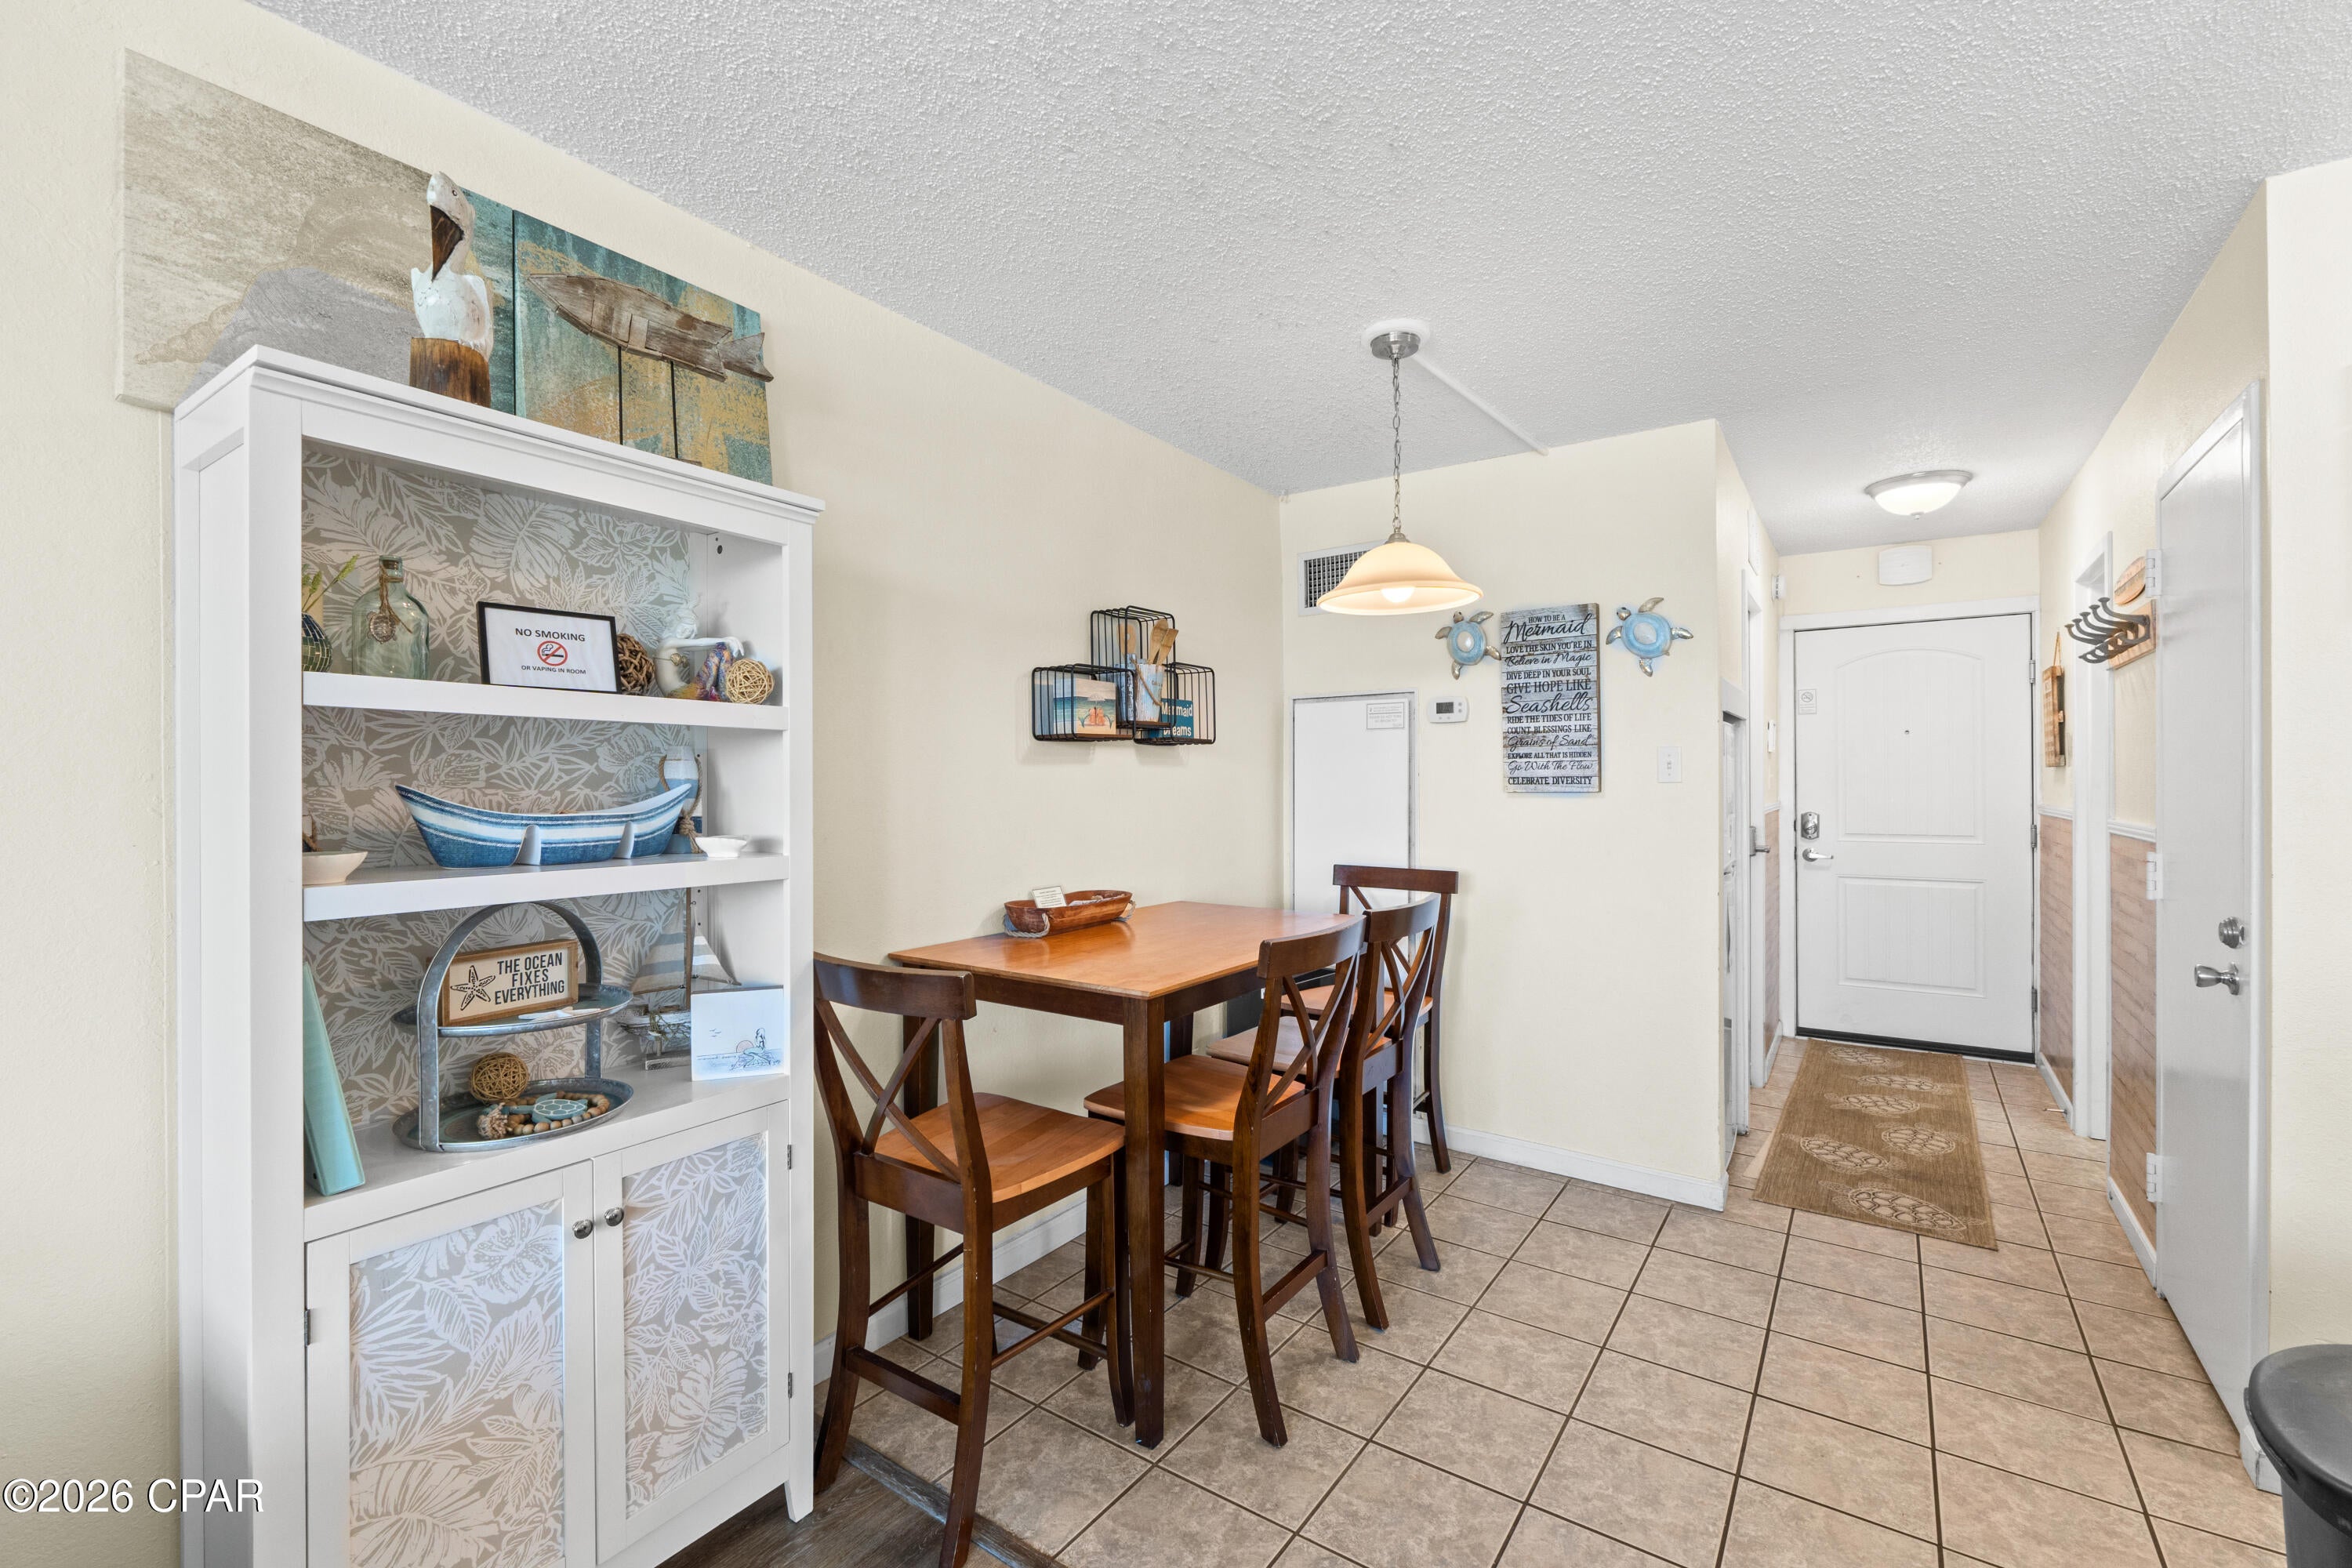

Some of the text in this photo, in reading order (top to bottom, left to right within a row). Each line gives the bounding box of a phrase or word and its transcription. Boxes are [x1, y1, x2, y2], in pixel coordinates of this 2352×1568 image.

[515, 628, 586, 641] NO SMOKING
[1504, 613, 1592, 644] Mermaid
[1506, 645, 1524, 654] LOVE
[1540, 643, 1558, 652] SKIN
[1558, 641, 1582, 650] YOU'RE
[1505, 655, 1539, 667] Believe
[1553, 652, 1592, 666] Magic
[1506, 672, 1523, 681] DIVE
[1552, 669, 1571, 677] YOUR
[1507, 679, 1592, 695] GIVE HOPE LIKE
[1162, 702, 1192, 717] Mrmaid
[1505, 691, 1593, 713] Seashells
[1541, 713, 1563, 722] TIDES
[1574, 713, 1592, 721] LIFE
[1534, 725, 1572, 734] BLESSINGS
[1508, 734, 1592, 752] Grains of Sand
[1508, 760, 1593, 775] Go With The Flow
[1552, 776, 1592, 785] DIVERSITY
[497, 952, 562, 975] THE OCEAN
[512, 968, 549, 987] FIXES
[495, 980, 564, 1005] EVERYTHING
